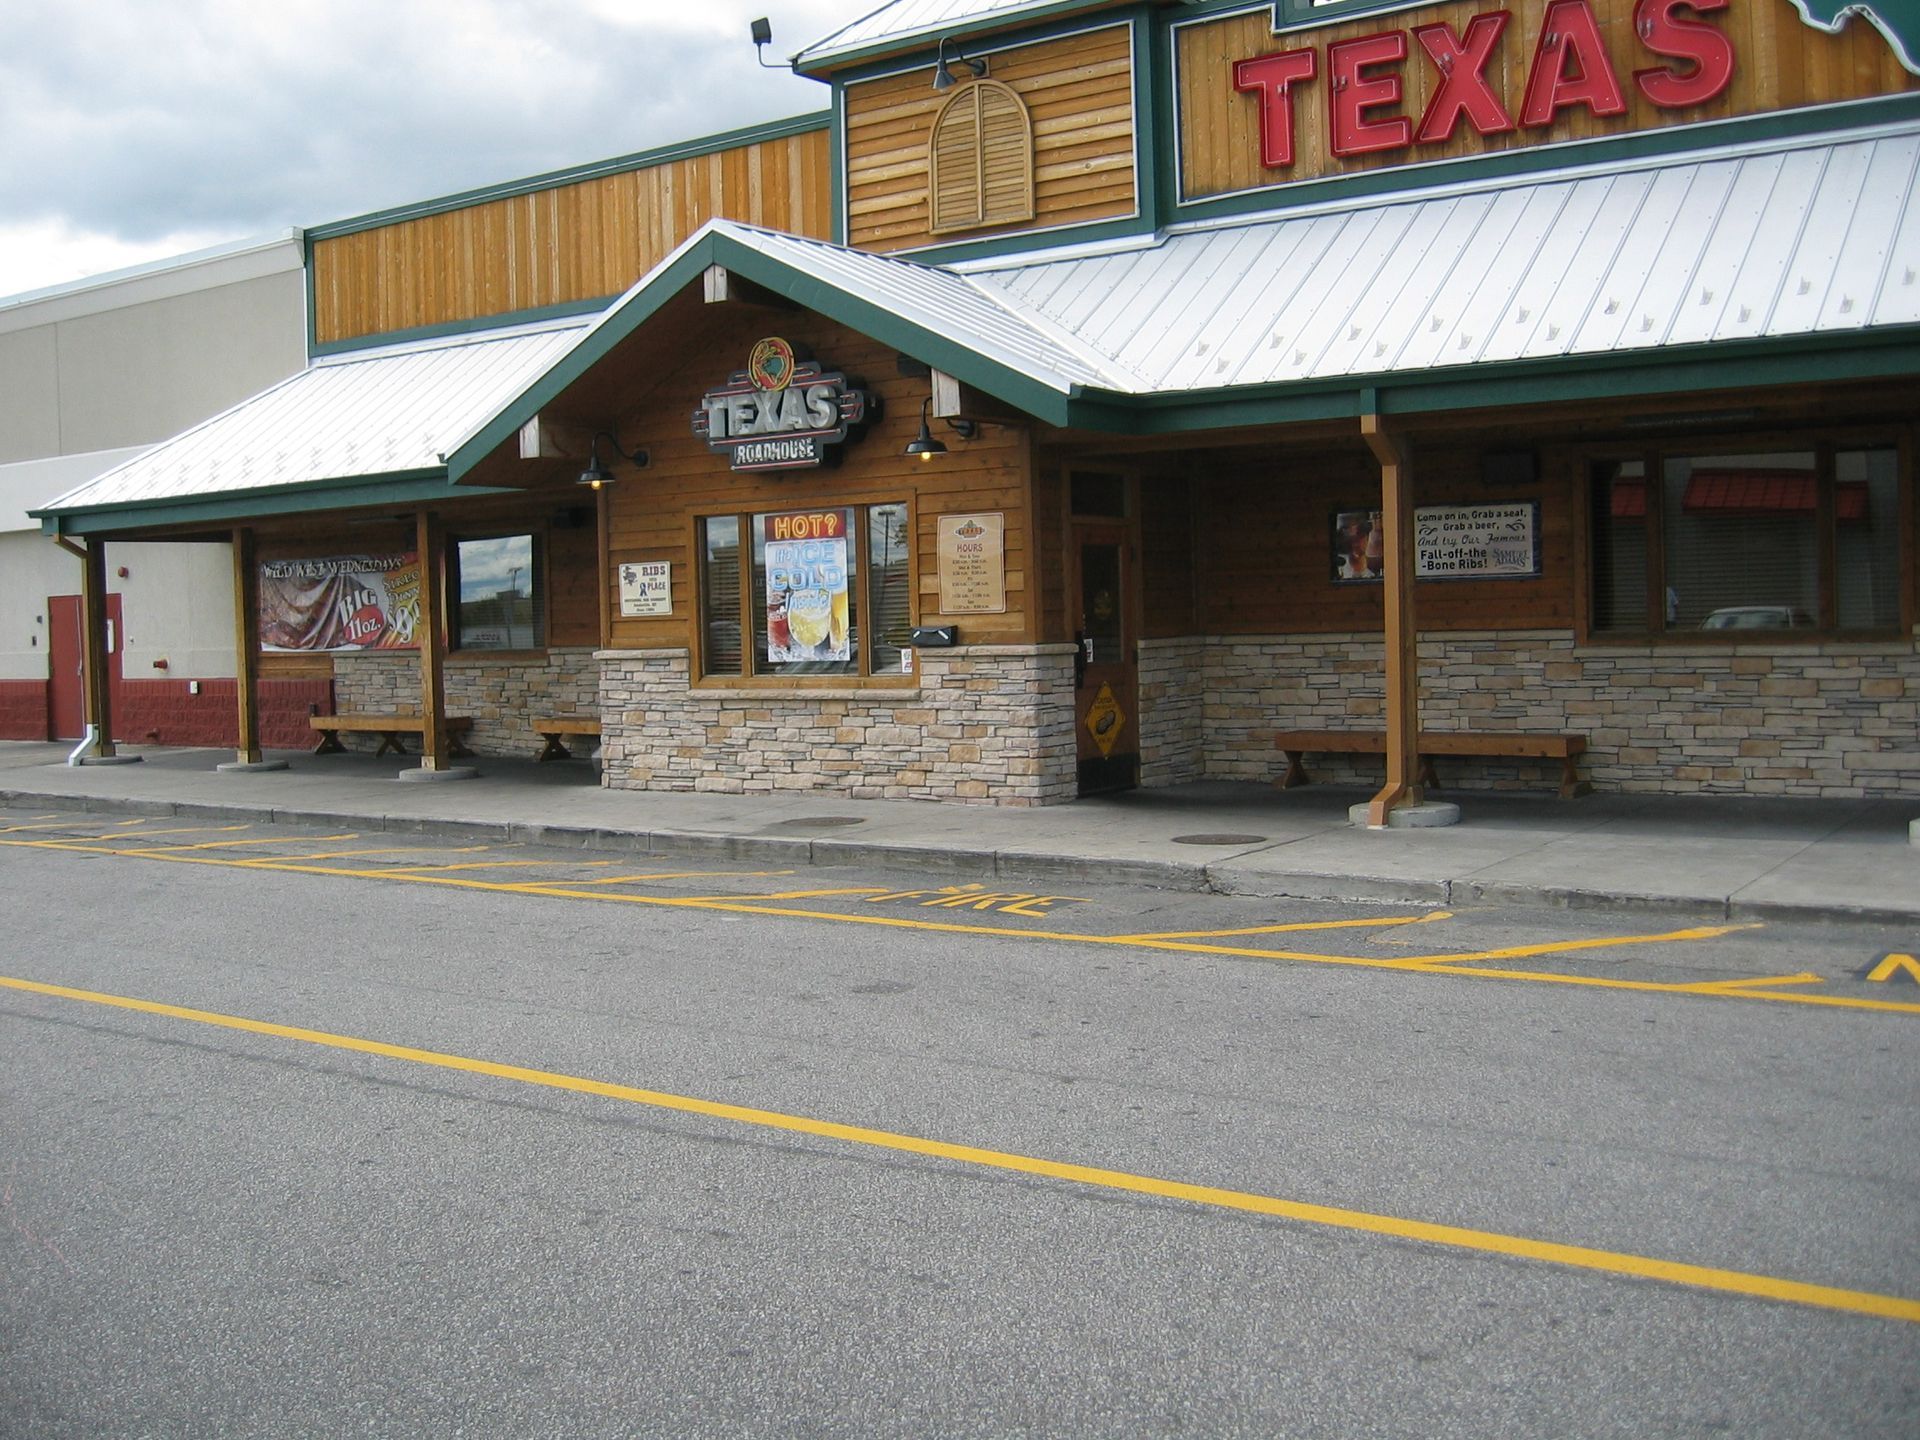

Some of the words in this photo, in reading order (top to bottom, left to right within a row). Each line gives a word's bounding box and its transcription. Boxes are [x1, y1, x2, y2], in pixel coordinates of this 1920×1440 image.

[1233, 0, 1735, 169] TEXAS
[702, 385, 838, 438] TEXAS
[735, 438, 815, 464] ROADHOUSE
[1417, 512, 1442, 522] Come
[1444, 513, 1456, 521] on
[1471, 509, 1494, 519] Grab
[1495, 510, 1502, 518] a
[774, 513, 838, 540] HOT?
[1443, 522, 1465, 531] Grab
[956, 543, 983, 553] HOURS
[1417, 535, 1438, 547] And
[1442, 536, 1458, 548] try
[1461, 534, 1480, 545] Our
[1485, 533, 1526, 546] Famous
[792, 542, 835, 567] ICE
[1420, 547, 1487, 560] Fall-off-the
[263, 563, 293, 579] WILD
[296, 561, 325, 578] WEST
[642, 565, 665, 576] RIBS
[1458, 559, 1488, 570] Ribs!
[771, 565, 844, 591] COLD
[339, 588, 378, 626] BIG
[864, 889, 1093, 917] FIRE
